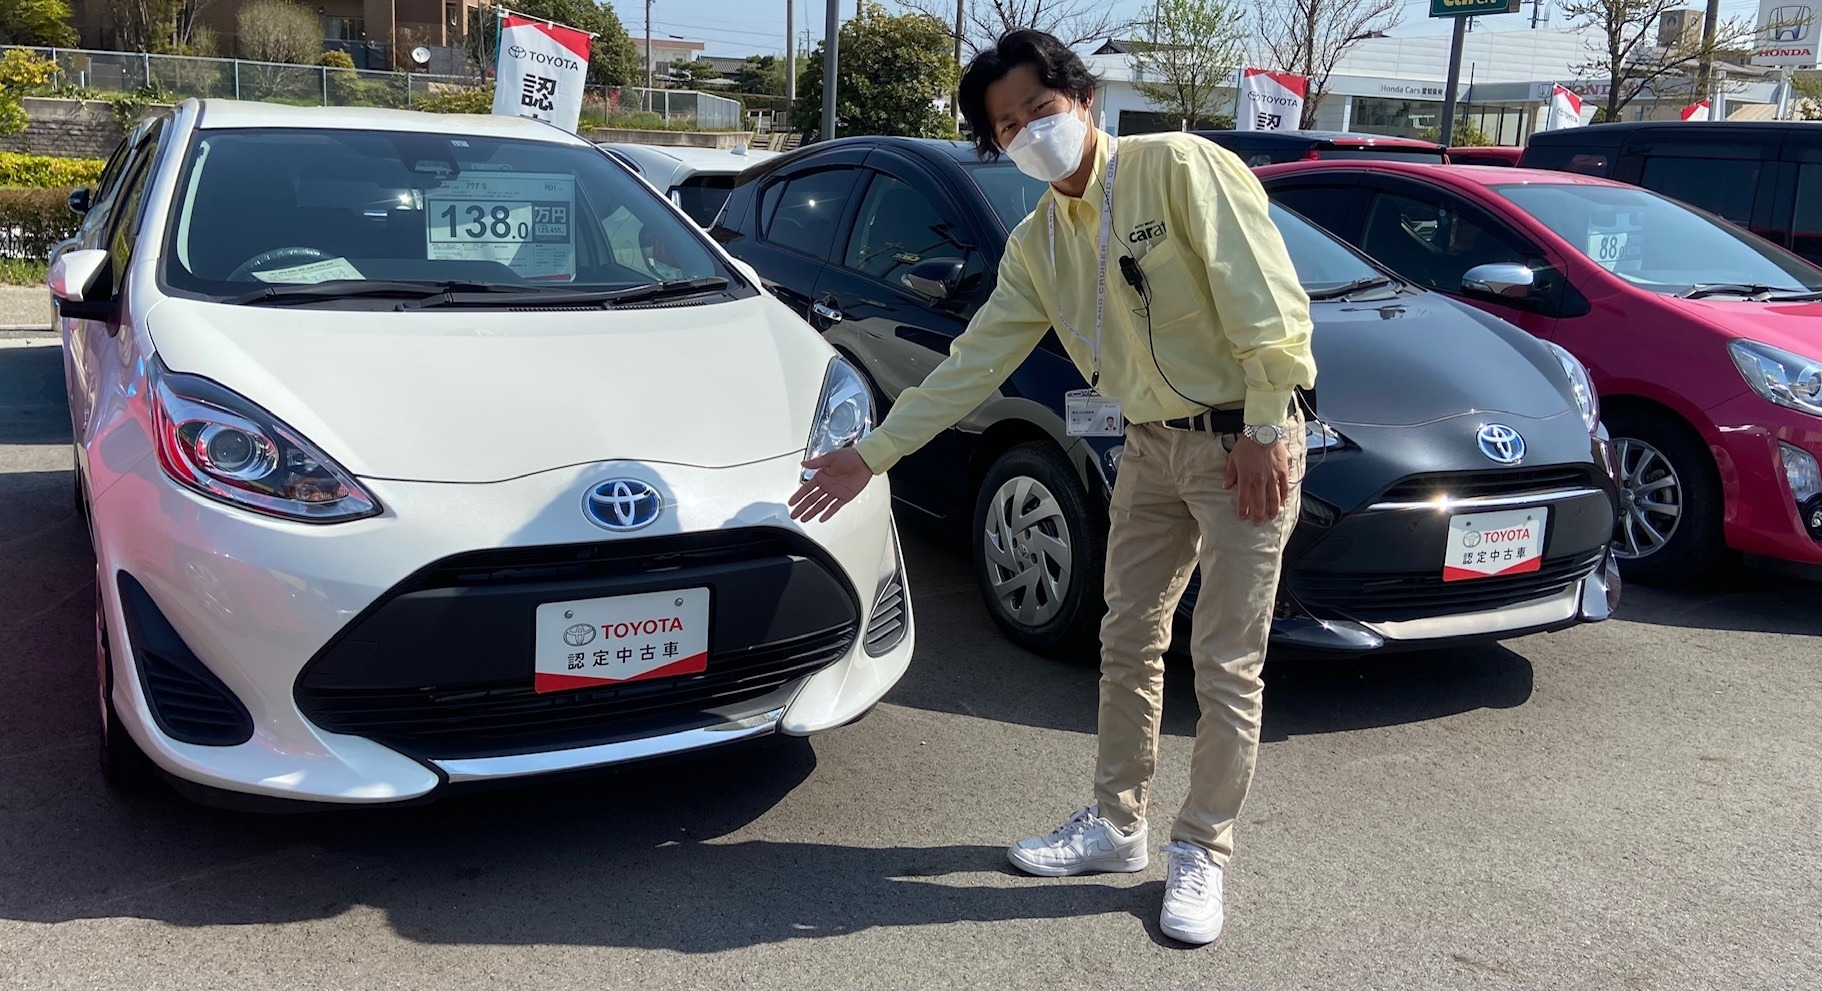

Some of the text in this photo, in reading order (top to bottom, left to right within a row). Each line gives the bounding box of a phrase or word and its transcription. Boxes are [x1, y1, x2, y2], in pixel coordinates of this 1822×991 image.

[529, 51, 579, 72] TOYOTA
[1759, 48, 1811, 57] HONDA
[1381, 85, 1403, 94] Honda
[1405, 86, 1420, 95] Cars
[1261, 94, 1298, 107] TOYOTA
[1104, 182, 1112, 213] LAND
[534, 206, 567, 223] 万円
[1129, 221, 1167, 243] carat
[1098, 245, 1107, 294] CRUISER
[1484, 528, 1530, 544] TOYOTA
[1463, 547, 1527, 565] 認定中古車
[601, 617, 684, 640] TOYOTA
[567, 641, 680, 671] 認定中古車
